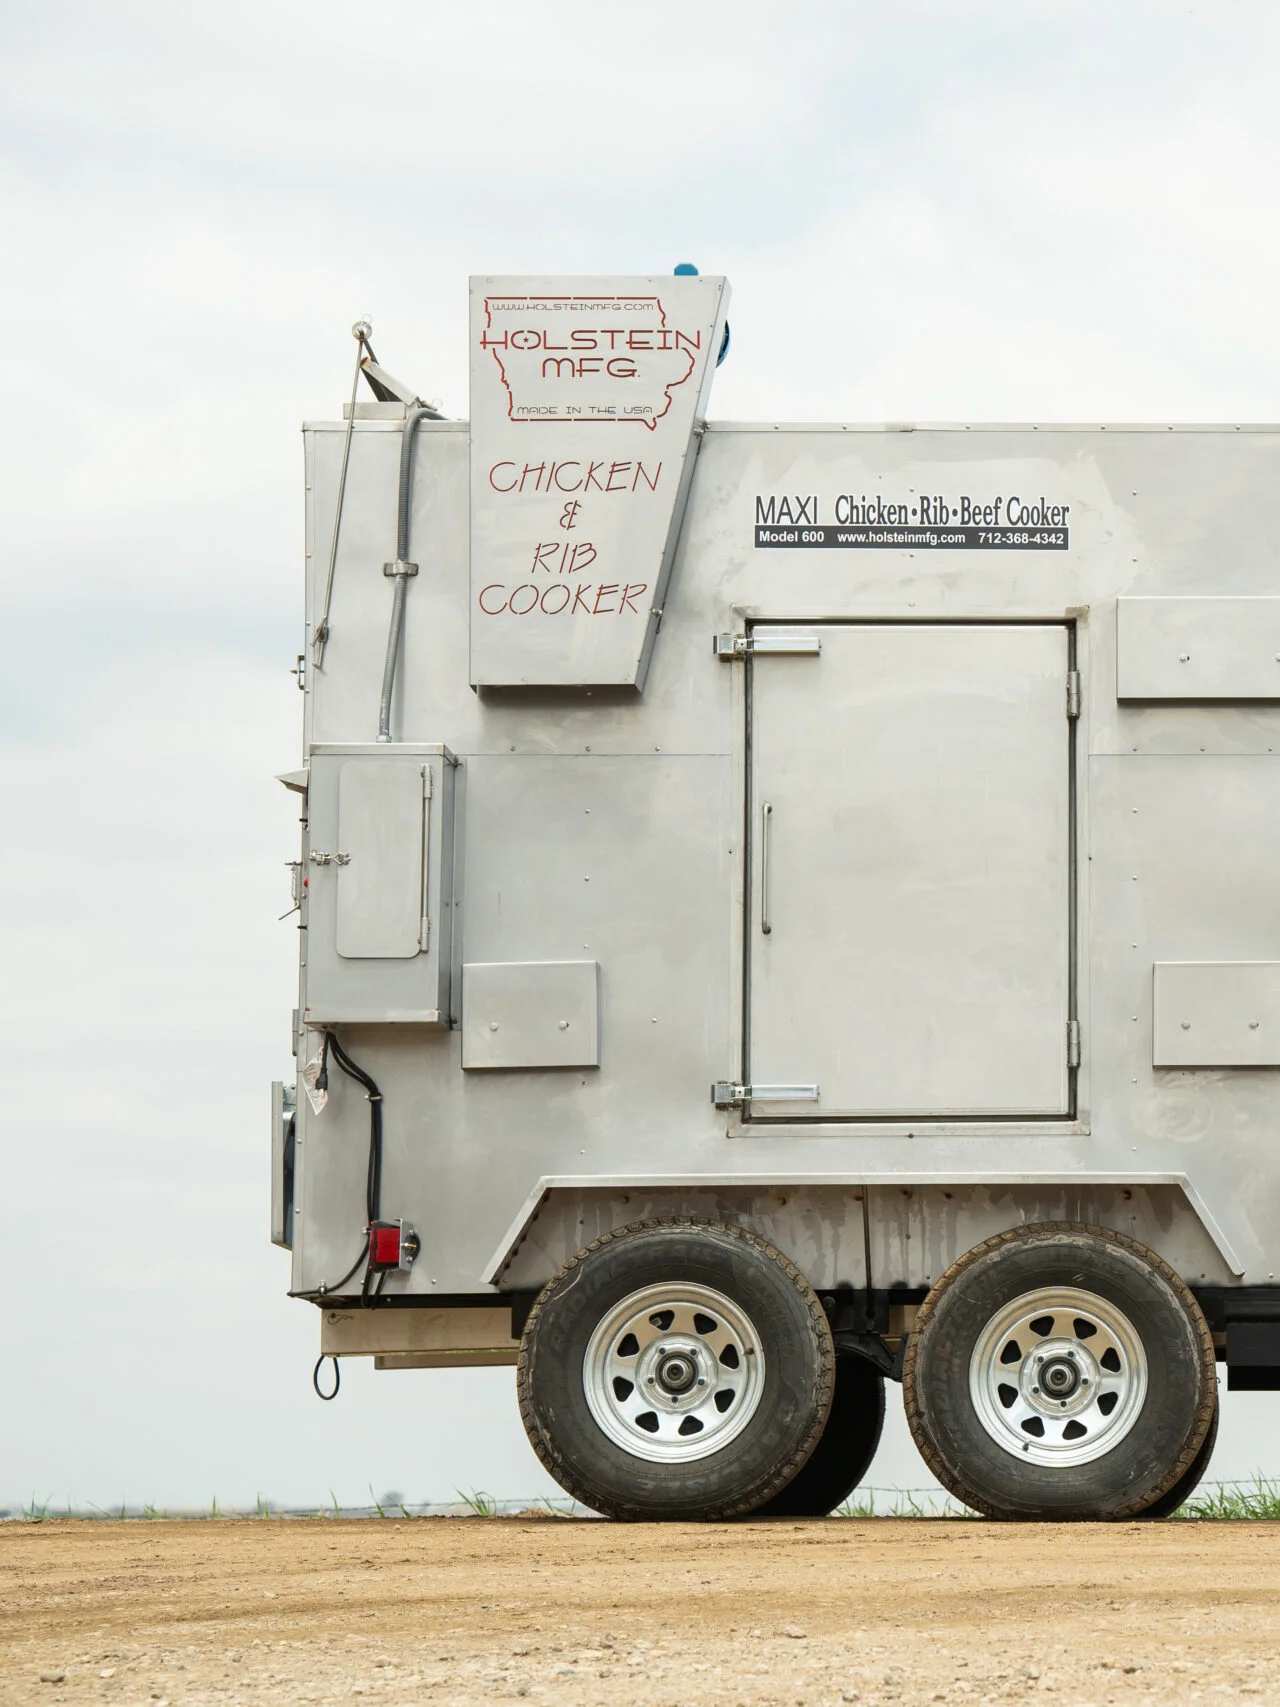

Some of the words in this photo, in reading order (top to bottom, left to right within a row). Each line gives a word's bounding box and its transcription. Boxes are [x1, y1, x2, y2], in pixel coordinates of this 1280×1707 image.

[480, 330, 701, 350] HOLSTEIN
[542, 358, 641, 378] MFG.
[517, 406, 558, 415] MADE
[566, 406, 582, 415] IN
[588, 406, 616, 415] THE
[624, 406, 653, 415] USA
[489, 461, 662, 492] CHICKEN
[559, 500, 582, 530] &
[755, 495, 818, 525] MAXI
[1006, 496, 1070, 527] Cooker
[759, 530, 798, 543] Model
[802, 530, 825, 543] 600
[837, 531, 966, 546] www.holsteinmfg.com
[978, 532, 1065, 545] 712-368-4342
[531, 542, 597, 573] RIB
[479, 584, 648, 615] COOKER
